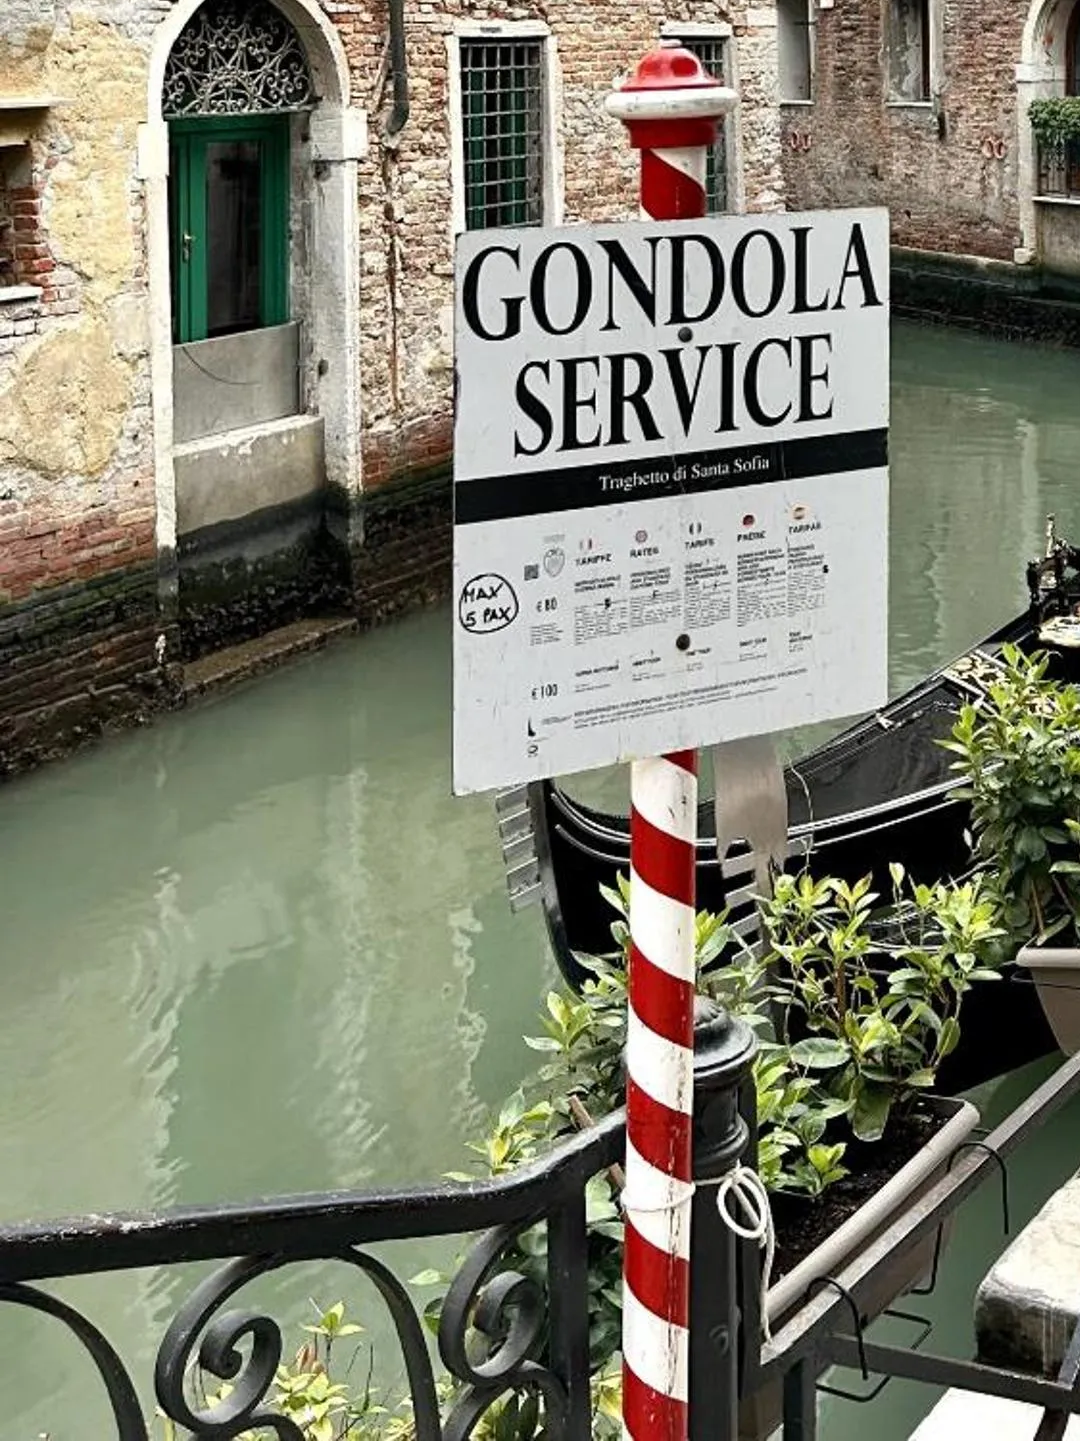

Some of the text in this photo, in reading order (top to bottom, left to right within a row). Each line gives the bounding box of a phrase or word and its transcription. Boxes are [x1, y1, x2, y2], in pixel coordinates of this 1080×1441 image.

[462, 222, 883, 341] GONDOLA
[514, 333, 833, 458] SERVICE
[599, 456, 770, 491] Traghetto di Santa Sofia
[464, 583, 504, 604] MAX
[465, 606, 512, 628] 5 PAX
